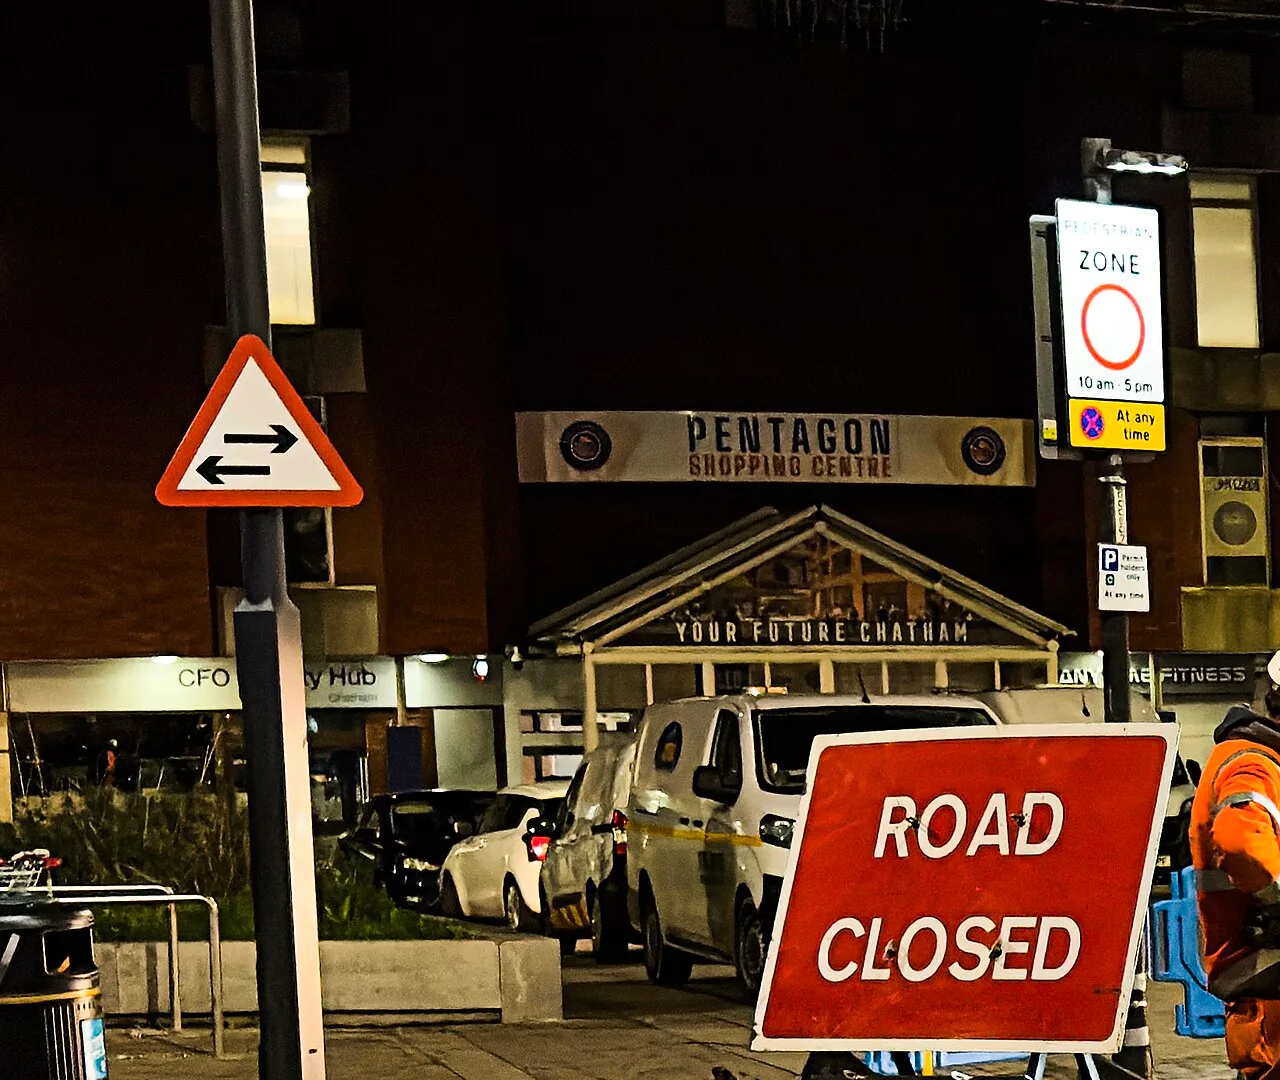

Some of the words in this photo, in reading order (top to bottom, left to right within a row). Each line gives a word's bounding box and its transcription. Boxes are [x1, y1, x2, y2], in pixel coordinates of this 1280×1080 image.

[1064, 219, 1153, 239] PEDESTRIAN
[1080, 250, 1140, 275] ZONE
[1079, 376, 1093, 389] 10
[1124, 378, 1132, 391] 5
[1135, 382, 1153, 394] pm
[1117, 409, 1130, 423] At
[1135, 413, 1155, 426] any
[687, 416, 890, 455] PENTAGON
[1123, 428, 1150, 441] time
[688, 454, 801, 477] SHOPPING
[812, 455, 892, 478] CENTRE
[675, 621, 737, 643] YOUR
[753, 621, 846, 643] FUTURE
[860, 621, 968, 643] CHATHAM
[178, 667, 231, 688] CFO
[329, 662, 377, 687] Hub
[1059, 667, 1151, 685] ANYME
[1159, 667, 1247, 684] FITNESS
[873, 792, 1064, 859] ROAD
[817, 916, 1082, 983] CLOSED
